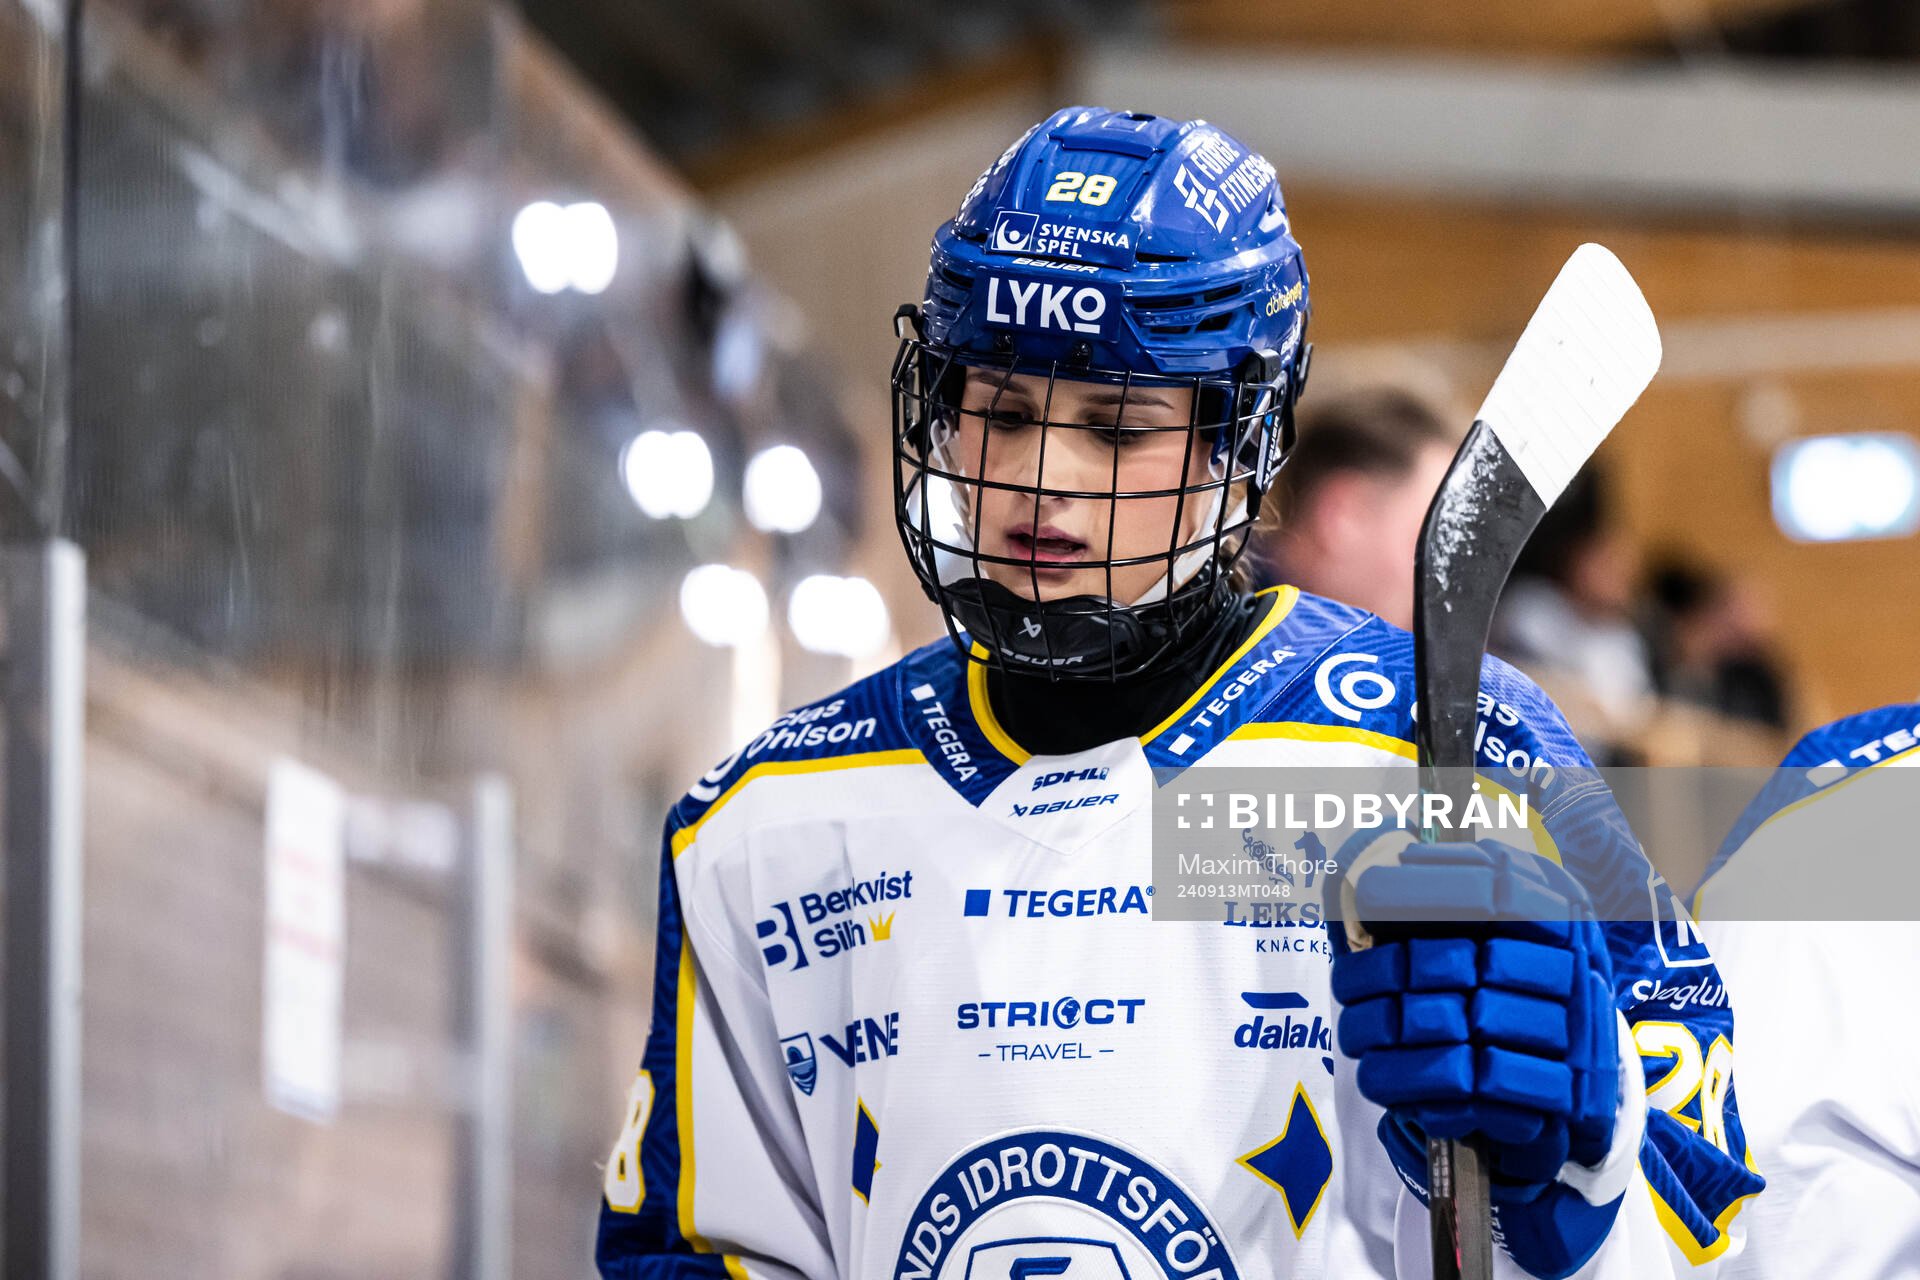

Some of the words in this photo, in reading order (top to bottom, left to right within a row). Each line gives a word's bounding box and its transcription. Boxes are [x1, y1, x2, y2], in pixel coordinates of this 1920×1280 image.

[1045, 171, 1118, 206] 28
[1036, 238, 1083, 258] SPEL
[1040, 223, 1130, 249] SVENSKA
[986, 277, 1106, 334] LYKO
[746, 717, 877, 759] Ohlson
[922, 702, 979, 782] TEGERA
[1474, 721, 1556, 790] lson
[1032, 767, 1100, 791] SDHL
[1223, 900, 1327, 929] LEKS
[1256, 936, 1332, 957] KNÄCKE
[1233, 1015, 1332, 1051] dalak
[995, 1042, 1093, 1062] TRAVEL
